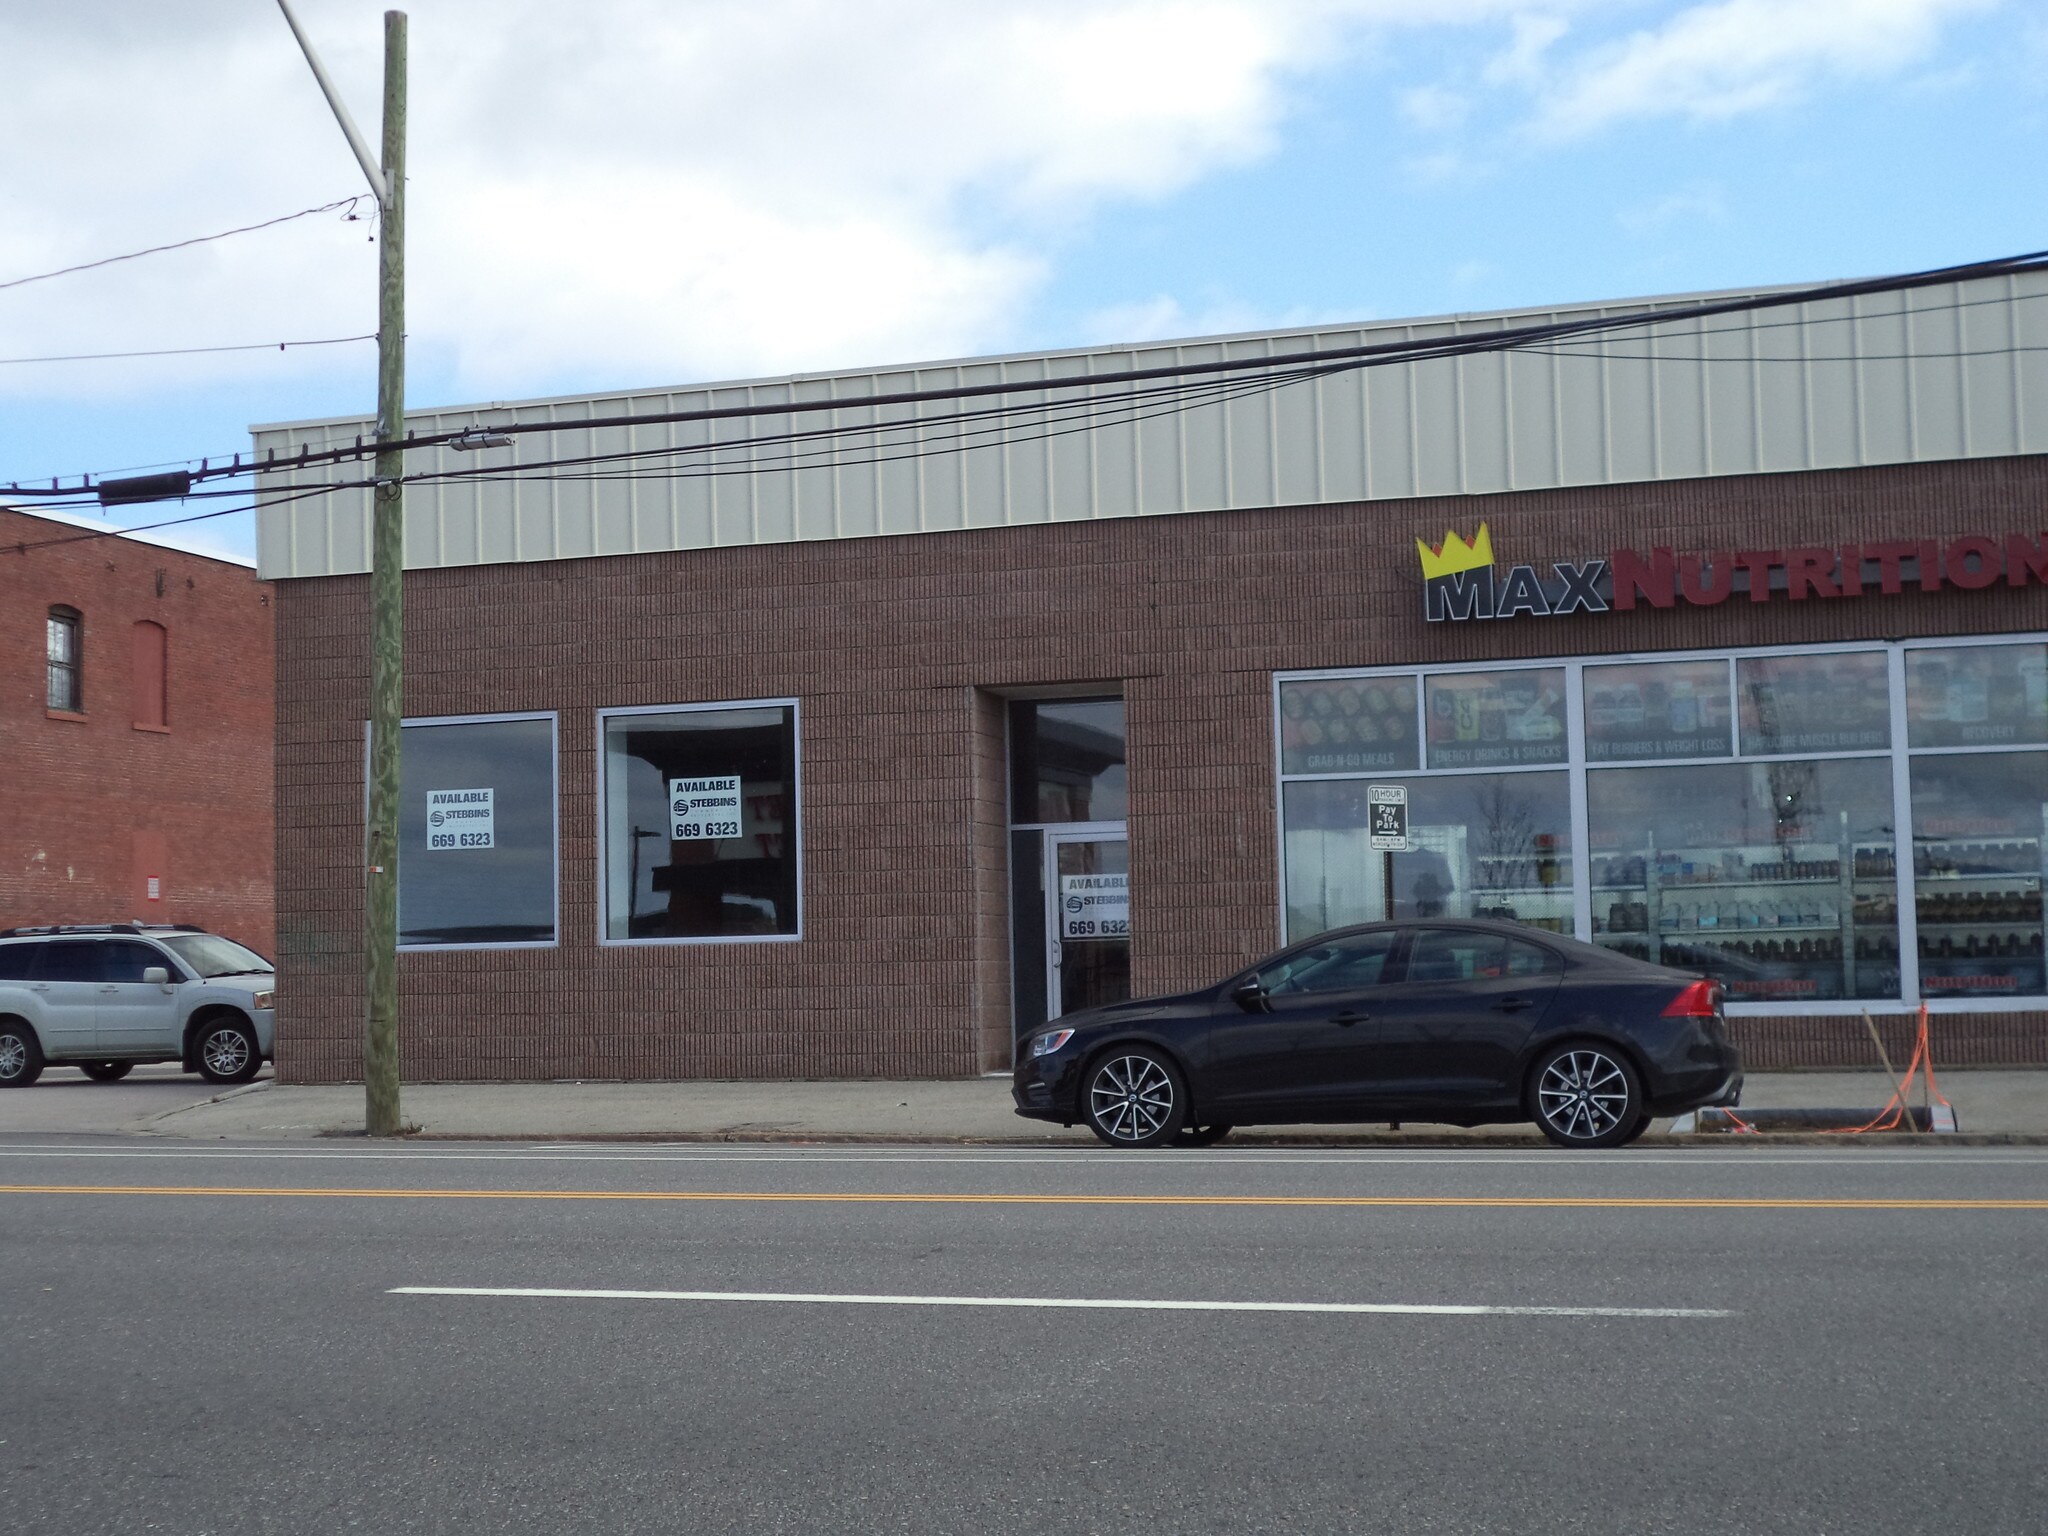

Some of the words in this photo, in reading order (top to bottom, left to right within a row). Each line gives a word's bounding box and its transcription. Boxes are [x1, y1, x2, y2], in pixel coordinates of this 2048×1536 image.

[1702, 738, 1726, 751] LOSS
[1363, 752, 1395, 766] MEALS
[1435, 749, 1472, 763] ENERGY
[1475, 747, 1510, 761] DRINKS
[1523, 745, 1561, 759] SNACKS
[676, 780, 735, 793] AVAILABLE
[432, 792, 489, 804] AVAILABLE
[1371, 790, 1379, 802] 10
[1380, 790, 1402, 798] HOUR
[690, 797, 737, 808] STEBBINS
[445, 808, 490, 819] STEBBINS
[1378, 804, 1397, 816] Pay
[1382, 813, 1394, 822] To
[675, 823, 700, 837] 669
[705, 821, 738, 836] 6323
[1376, 819, 1400, 829] Park
[432, 833, 456, 847] 669
[460, 832, 491, 846] 6323
[1069, 877, 1129, 889] AVAILABL
[1083, 894, 1129, 905] STEBBIN
[1069, 920, 1095, 935] 669
[1101, 919, 1130, 934] 632
